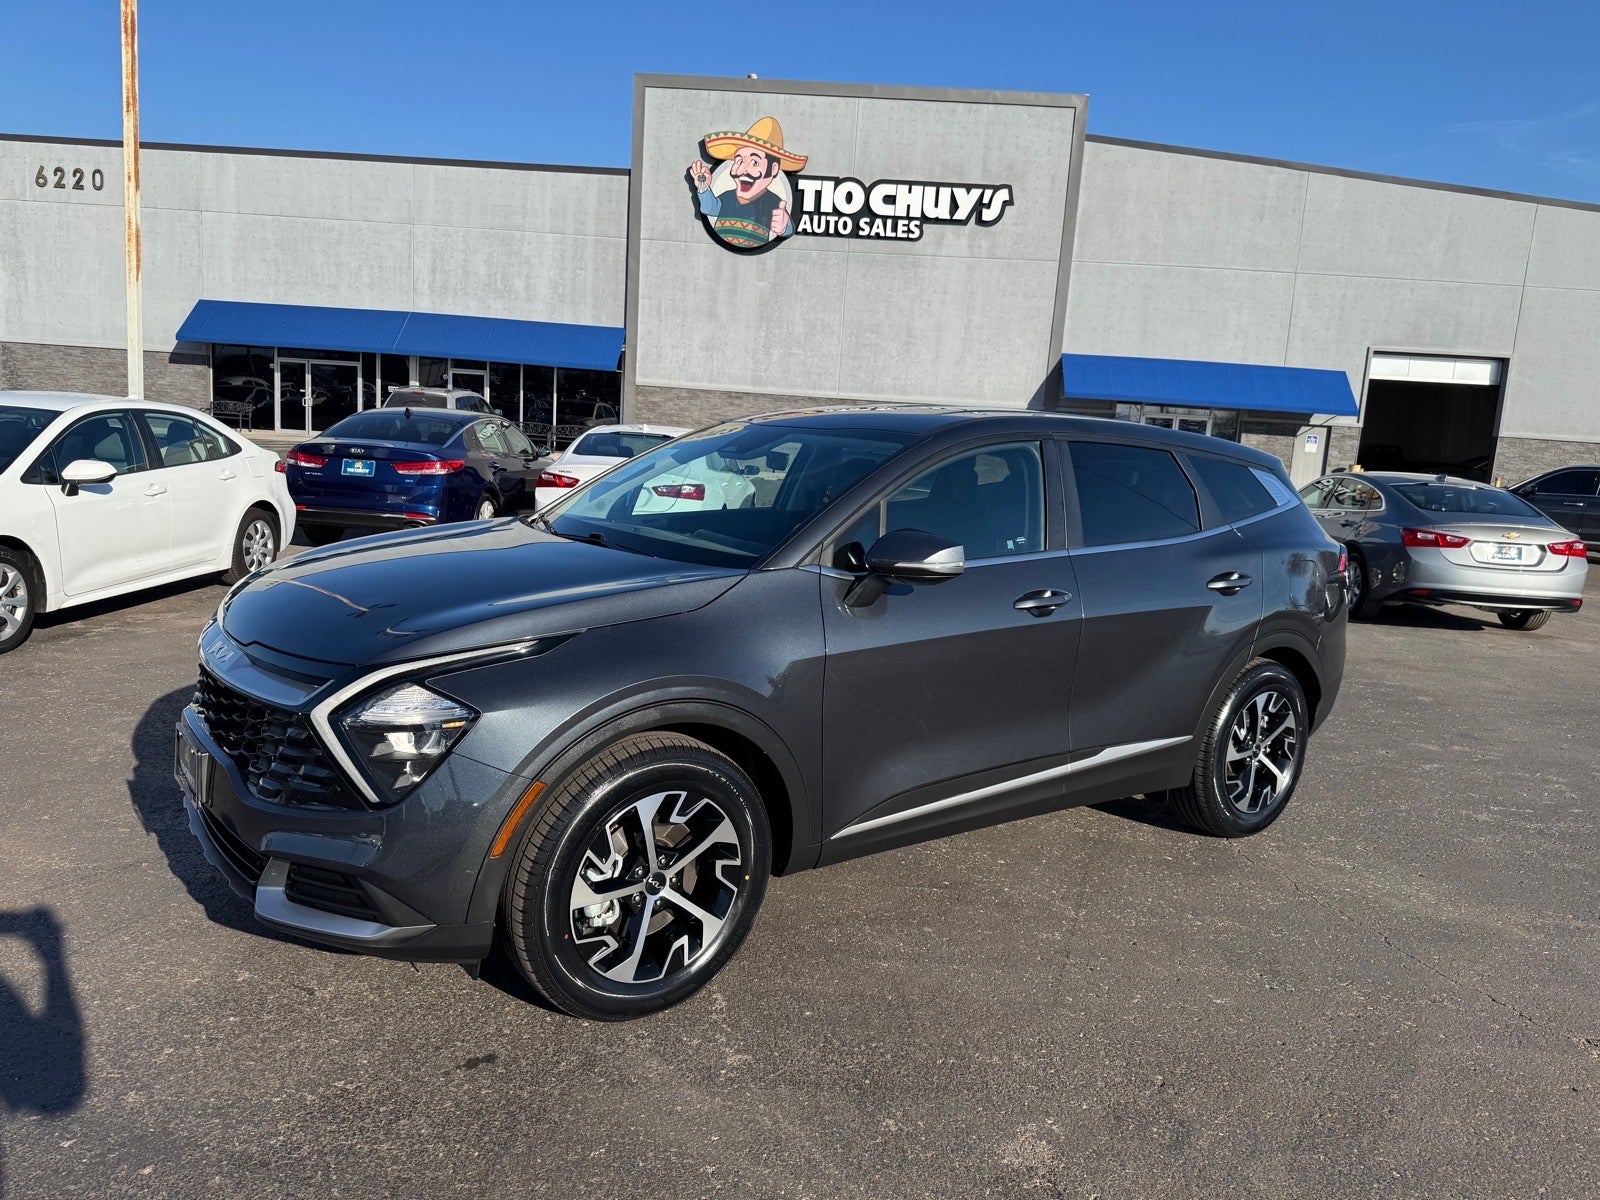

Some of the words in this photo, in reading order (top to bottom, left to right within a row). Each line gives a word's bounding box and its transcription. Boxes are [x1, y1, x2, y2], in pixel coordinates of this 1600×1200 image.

[35, 165, 104, 191] 6220
[797, 179, 866, 215] TIO
[797, 214, 853, 235] AUTO
[858, 217, 921, 239] SALES
